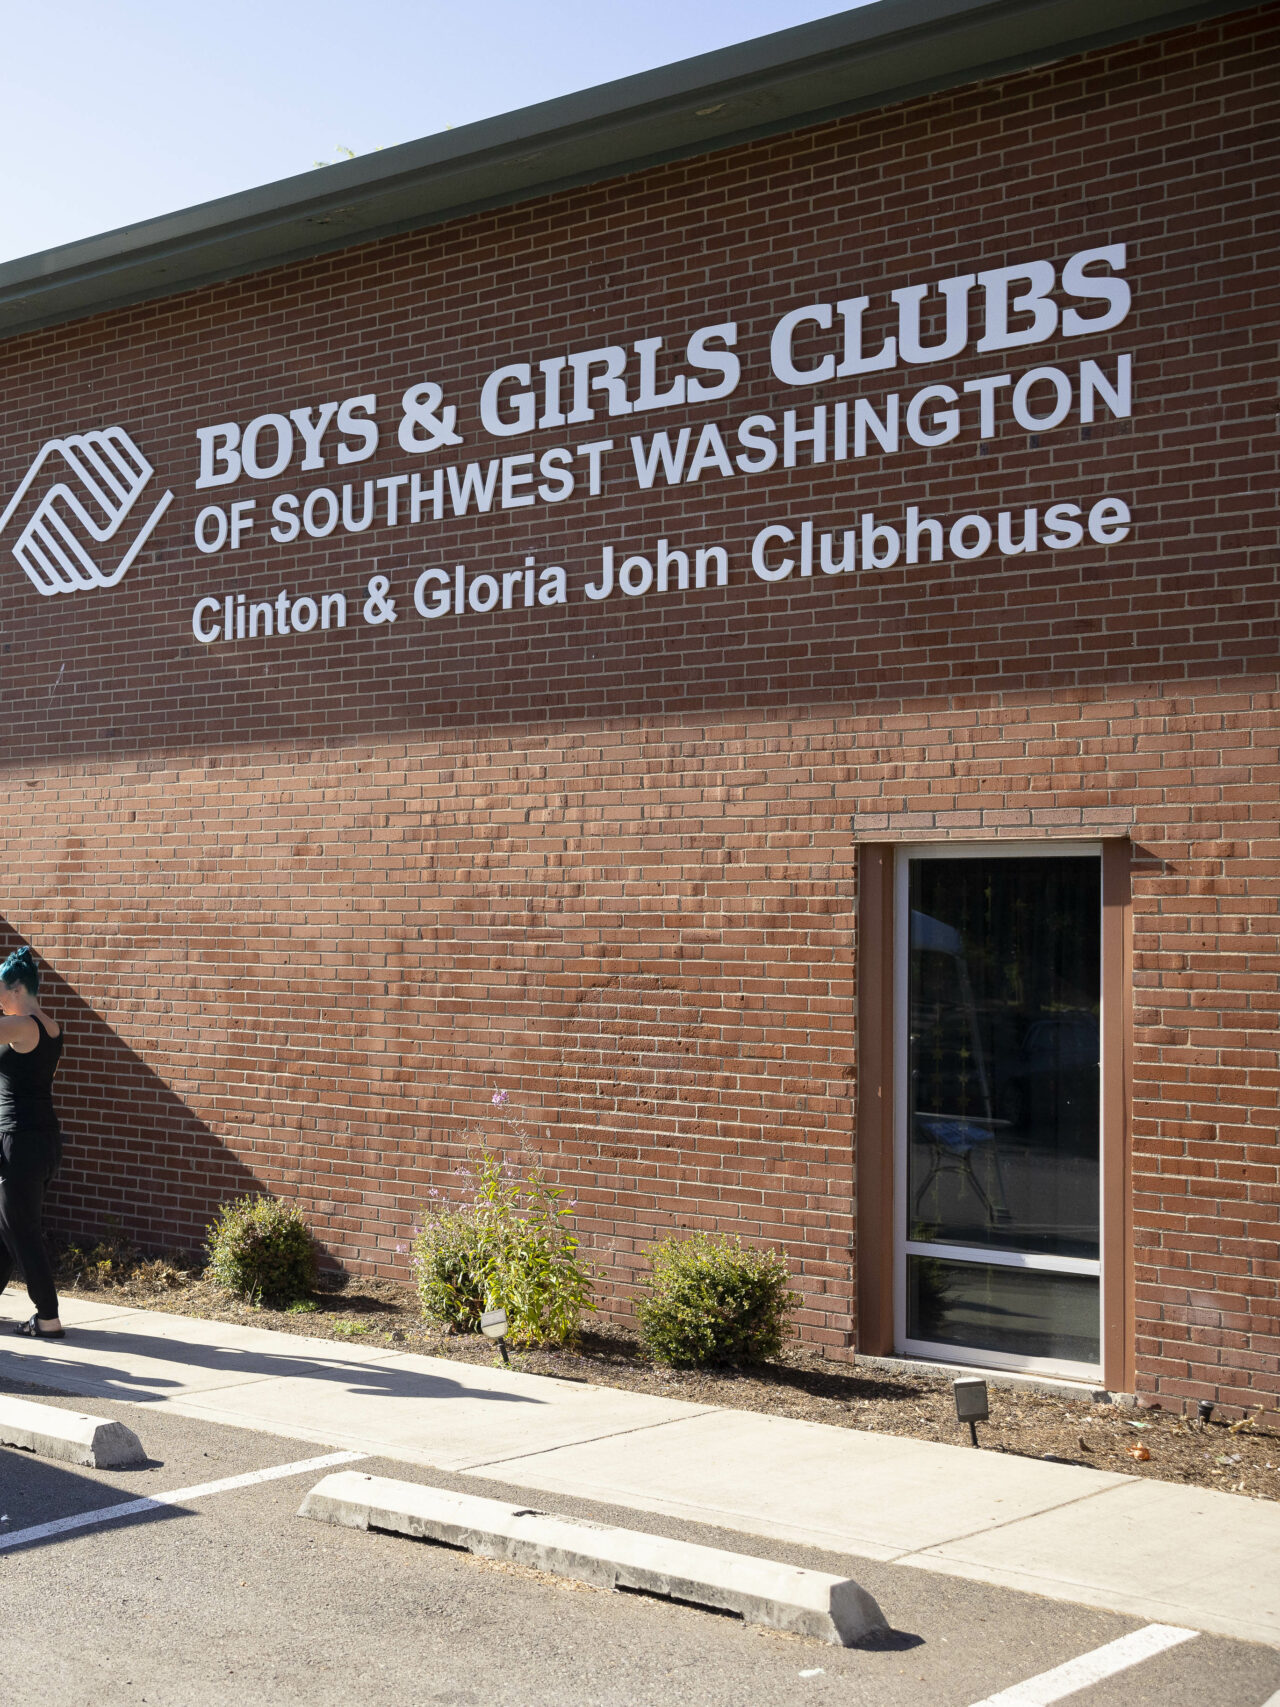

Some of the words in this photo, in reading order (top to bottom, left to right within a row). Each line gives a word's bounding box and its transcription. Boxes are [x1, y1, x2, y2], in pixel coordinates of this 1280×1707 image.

[194, 499, 256, 554] OF
[270, 439, 614, 543] SOUTHWEST
[630, 353, 1131, 489] WASHINGTON
[195, 393, 378, 490] BOYS
[397, 382, 464, 454] &
[480, 321, 740, 437] GIRLS
[770, 243, 1131, 386] CLUBS
[192, 589, 347, 643] Clinton
[362, 575, 398, 625] &
[413, 565, 567, 619] Gloria
[584, 538, 728, 600] John
[751, 497, 1131, 582] Clubhouse
